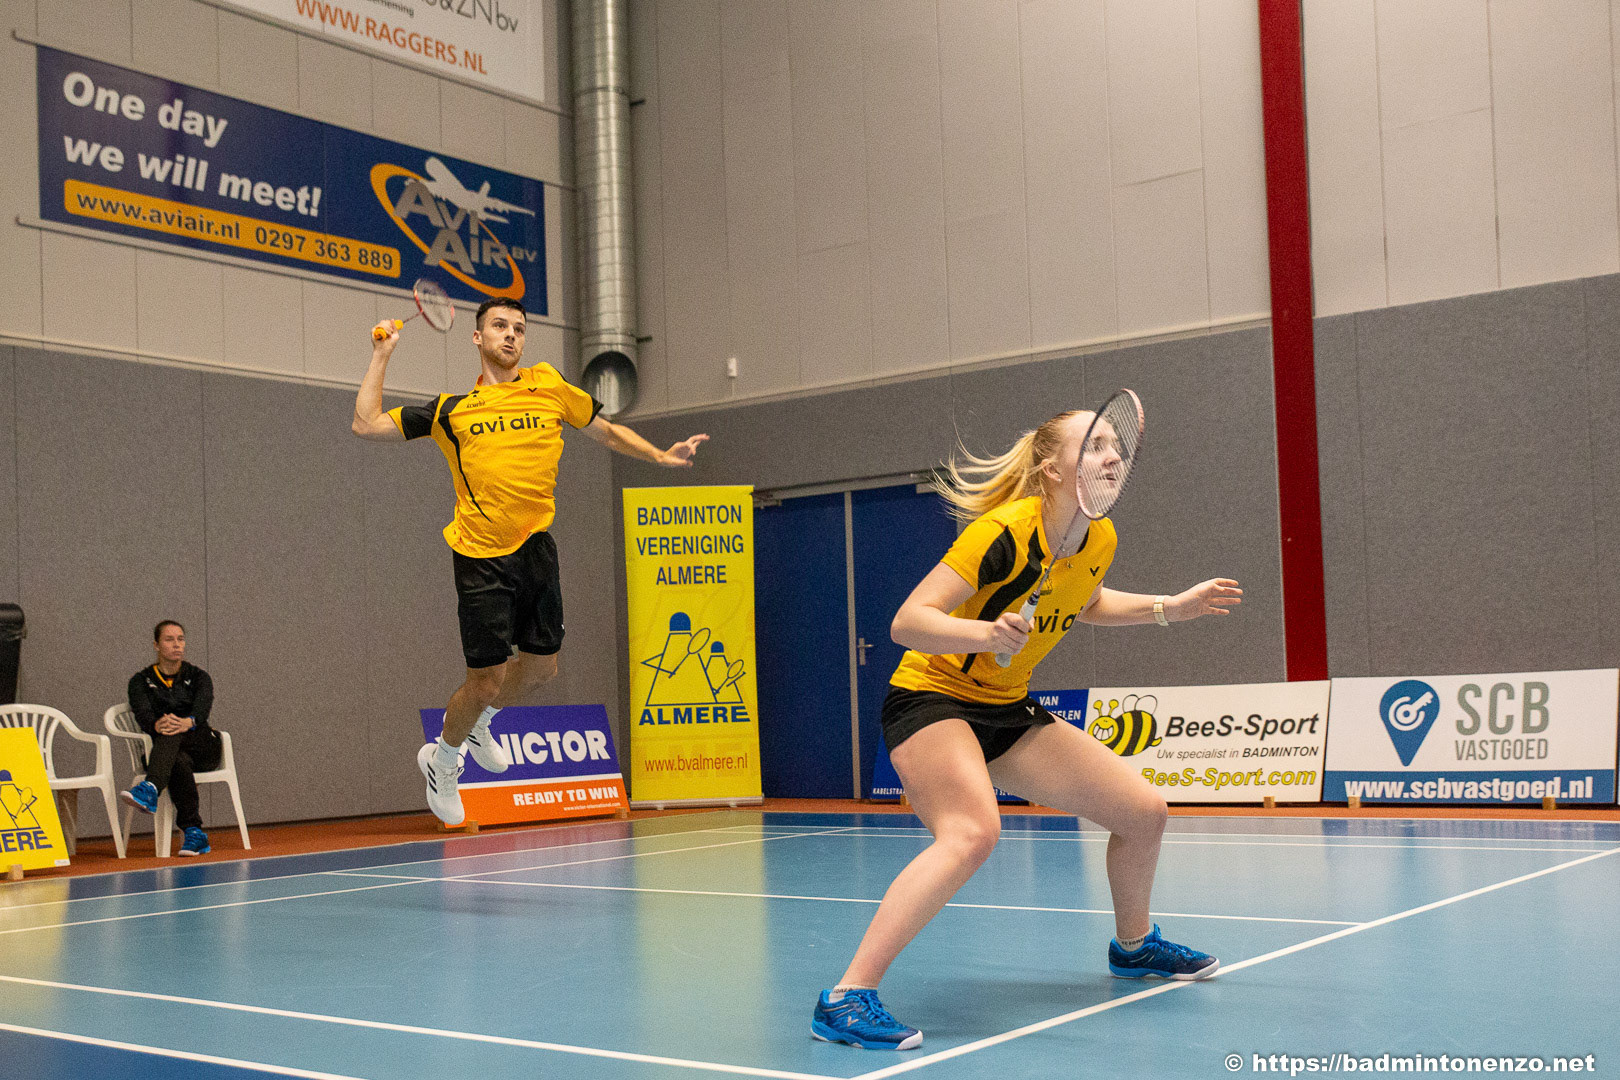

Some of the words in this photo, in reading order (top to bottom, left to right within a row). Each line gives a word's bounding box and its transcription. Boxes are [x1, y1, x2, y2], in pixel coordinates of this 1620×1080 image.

[296, 0, 488, 75] WWW.RAGGERS.NL
[63, 72, 145, 121] One
[158, 98, 228, 148] day
[64, 136, 125, 172] we
[138, 153, 209, 192] will
[219, 172, 322, 217] meet!
[77, 193, 241, 240] www.aviair.nl
[255, 226, 306, 252] 0297
[315, 239, 351, 262] 363
[358, 249, 394, 271] 889
[512, 246, 537, 262] BV
[470, 416, 505, 435] avi
[510, 413, 545, 431] air.
[637, 504, 742, 526] BADMINTON
[636, 534, 744, 556] VERENIGING
[656, 565, 727, 586] ALMERE
[1029, 609, 1059, 633] vi
[1039, 695, 1059, 706] VAN
[1456, 681, 1549, 736] SCB
[639, 705, 751, 726] ALMERE
[1165, 713, 1319, 741] BeeS-Sport
[1156, 749, 1175, 759] Uw
[1177, 748, 1228, 761] specialist
[1229, 748, 1239, 758] in
[1242, 746, 1319, 758] BADMINTON
[1455, 738, 1549, 760] VASTGOED
[645, 753, 748, 772] www.bvalmere.nl
[1141, 767, 1317, 790] BeeS-Sport.com
[1344, 776, 1593, 801] www.scbvastgoed.nl
[513, 791, 564, 806] READY
[567, 789, 587, 802] TO
[588, 785, 619, 800] WIN
[872, 787, 906, 795] KABELSTRA
[0, 830, 53, 853] ERE
